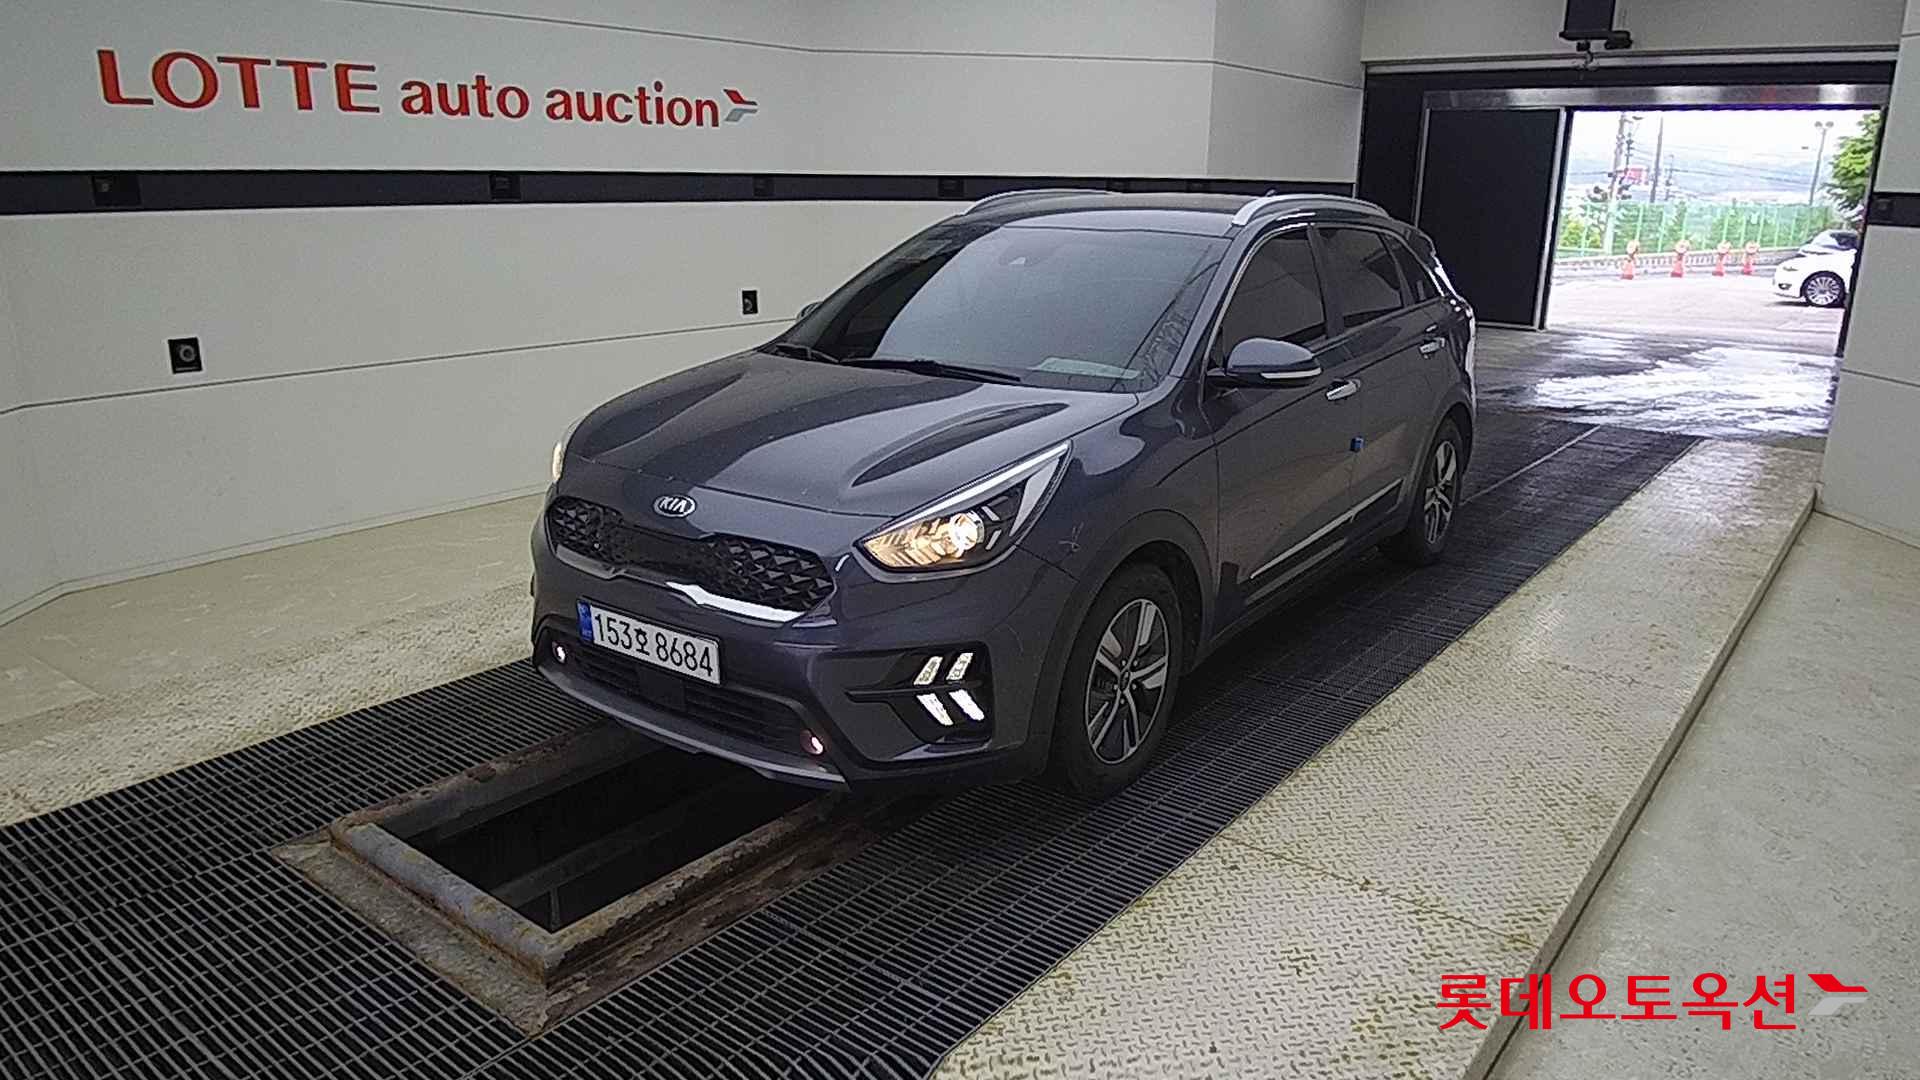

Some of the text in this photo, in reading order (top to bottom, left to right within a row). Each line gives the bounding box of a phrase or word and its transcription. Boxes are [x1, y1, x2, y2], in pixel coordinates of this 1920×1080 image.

[97, 49, 720, 128] LOTTE auto auction
[658, 496, 689, 513] KIA
